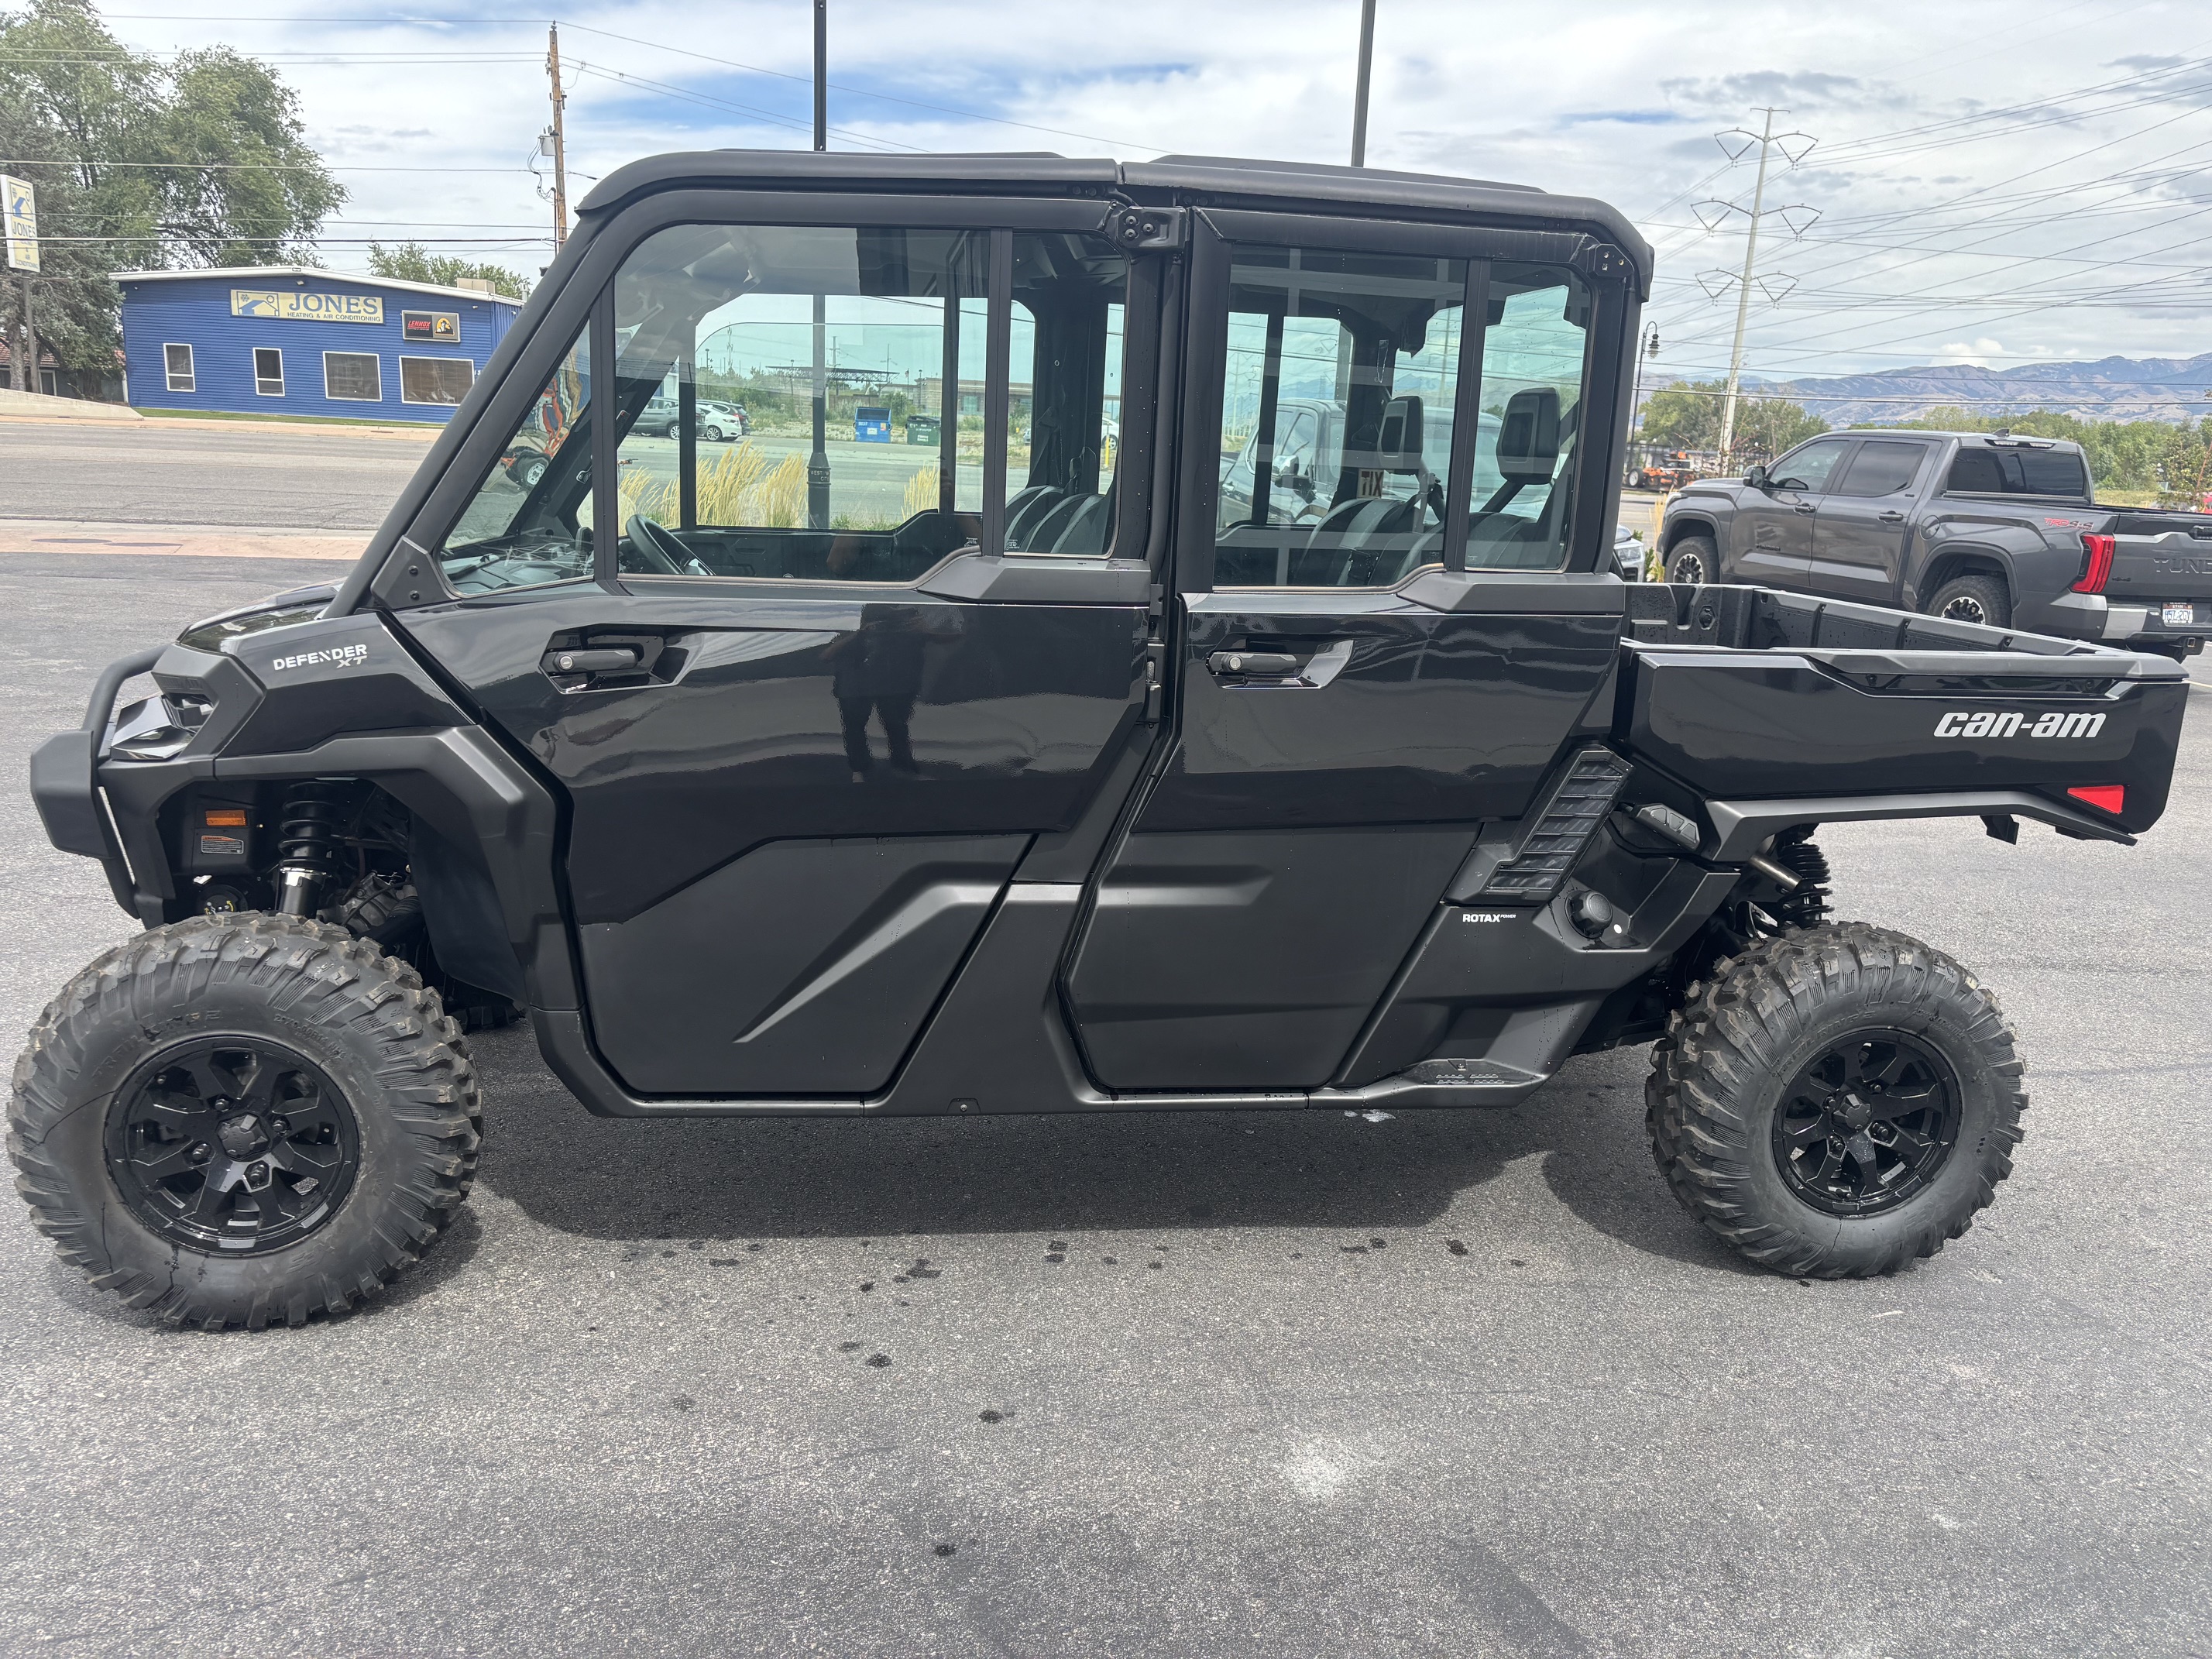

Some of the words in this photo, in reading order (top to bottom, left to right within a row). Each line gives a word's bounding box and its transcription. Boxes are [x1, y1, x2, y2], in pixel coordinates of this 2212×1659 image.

[12, 222, 36, 238] JONES
[289, 294, 378, 315] JONES
[407, 320, 431, 328] LENNOX
[2044, 517, 2070, 527] TRD
[273, 644, 368, 671] DEFENDER
[336, 655, 368, 668] XT
[1933, 713, 2107, 737] can-am
[1462, 914, 1501, 922] ROTAX
